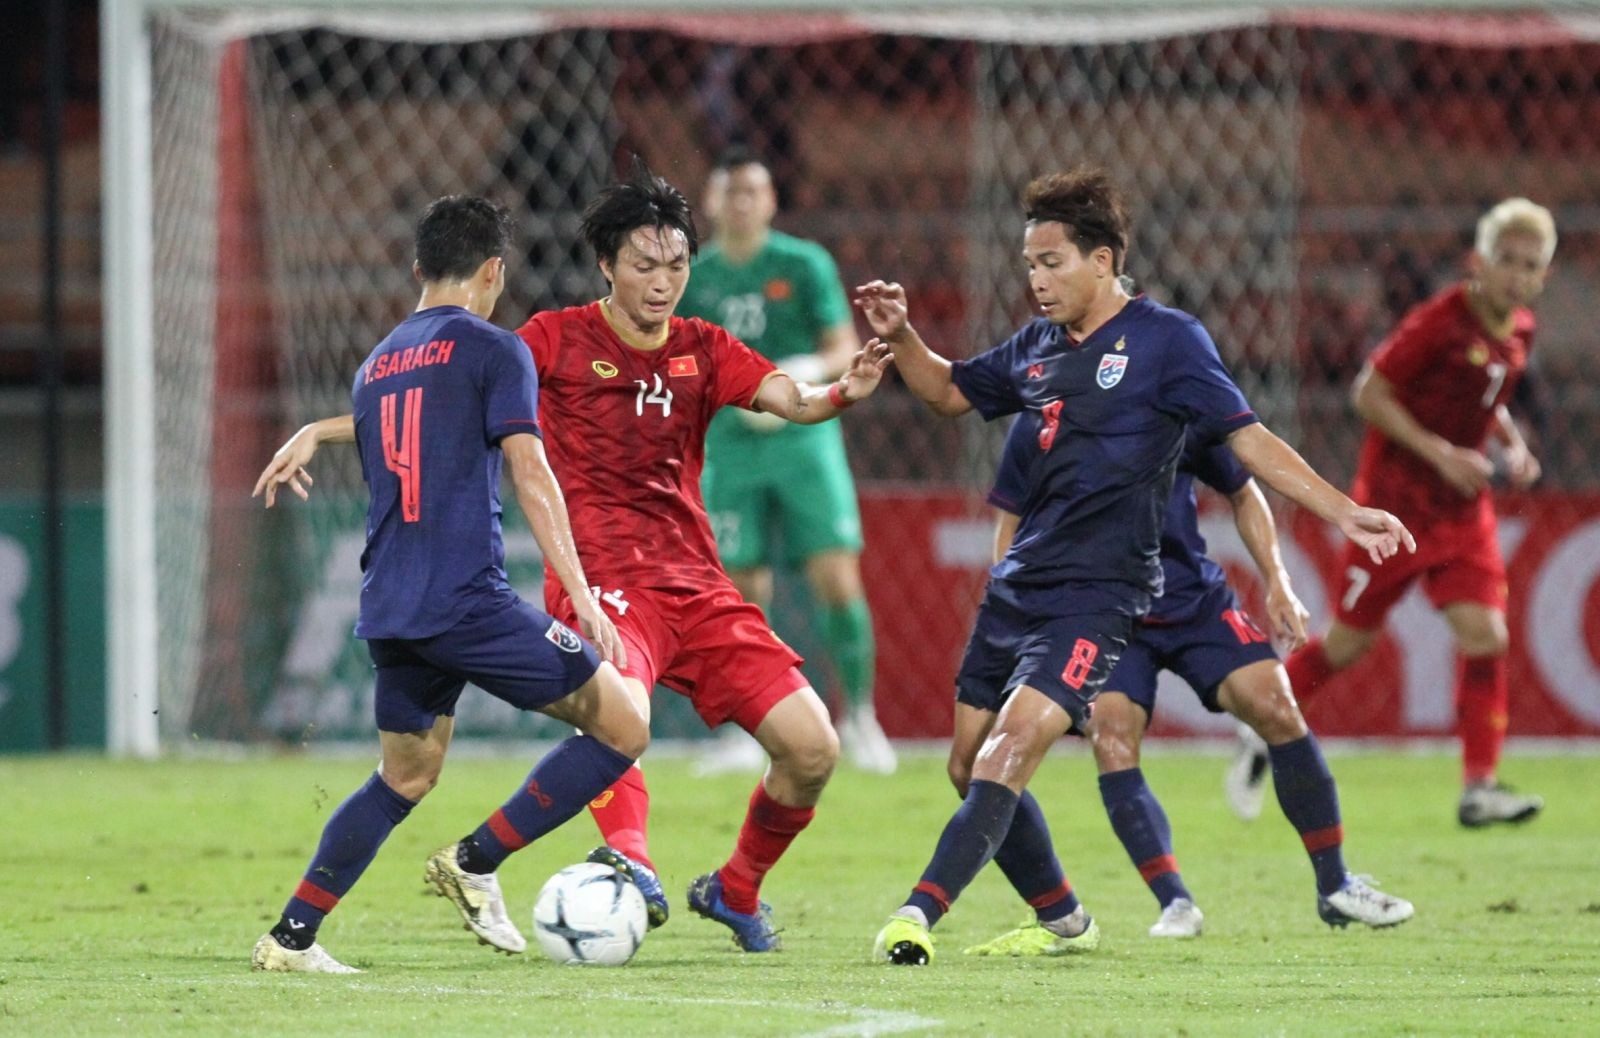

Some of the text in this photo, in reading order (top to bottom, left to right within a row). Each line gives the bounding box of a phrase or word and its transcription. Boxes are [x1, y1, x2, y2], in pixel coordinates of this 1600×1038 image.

[718, 293, 766, 339] 23
[364, 340, 456, 385] Y.SARACH
[1483, 362, 1508, 409] 7
[634, 373, 673, 418] 14
[381, 387, 423, 522] 4
[1343, 564, 1371, 612] 7
[1062, 637, 1098, 690] 8
